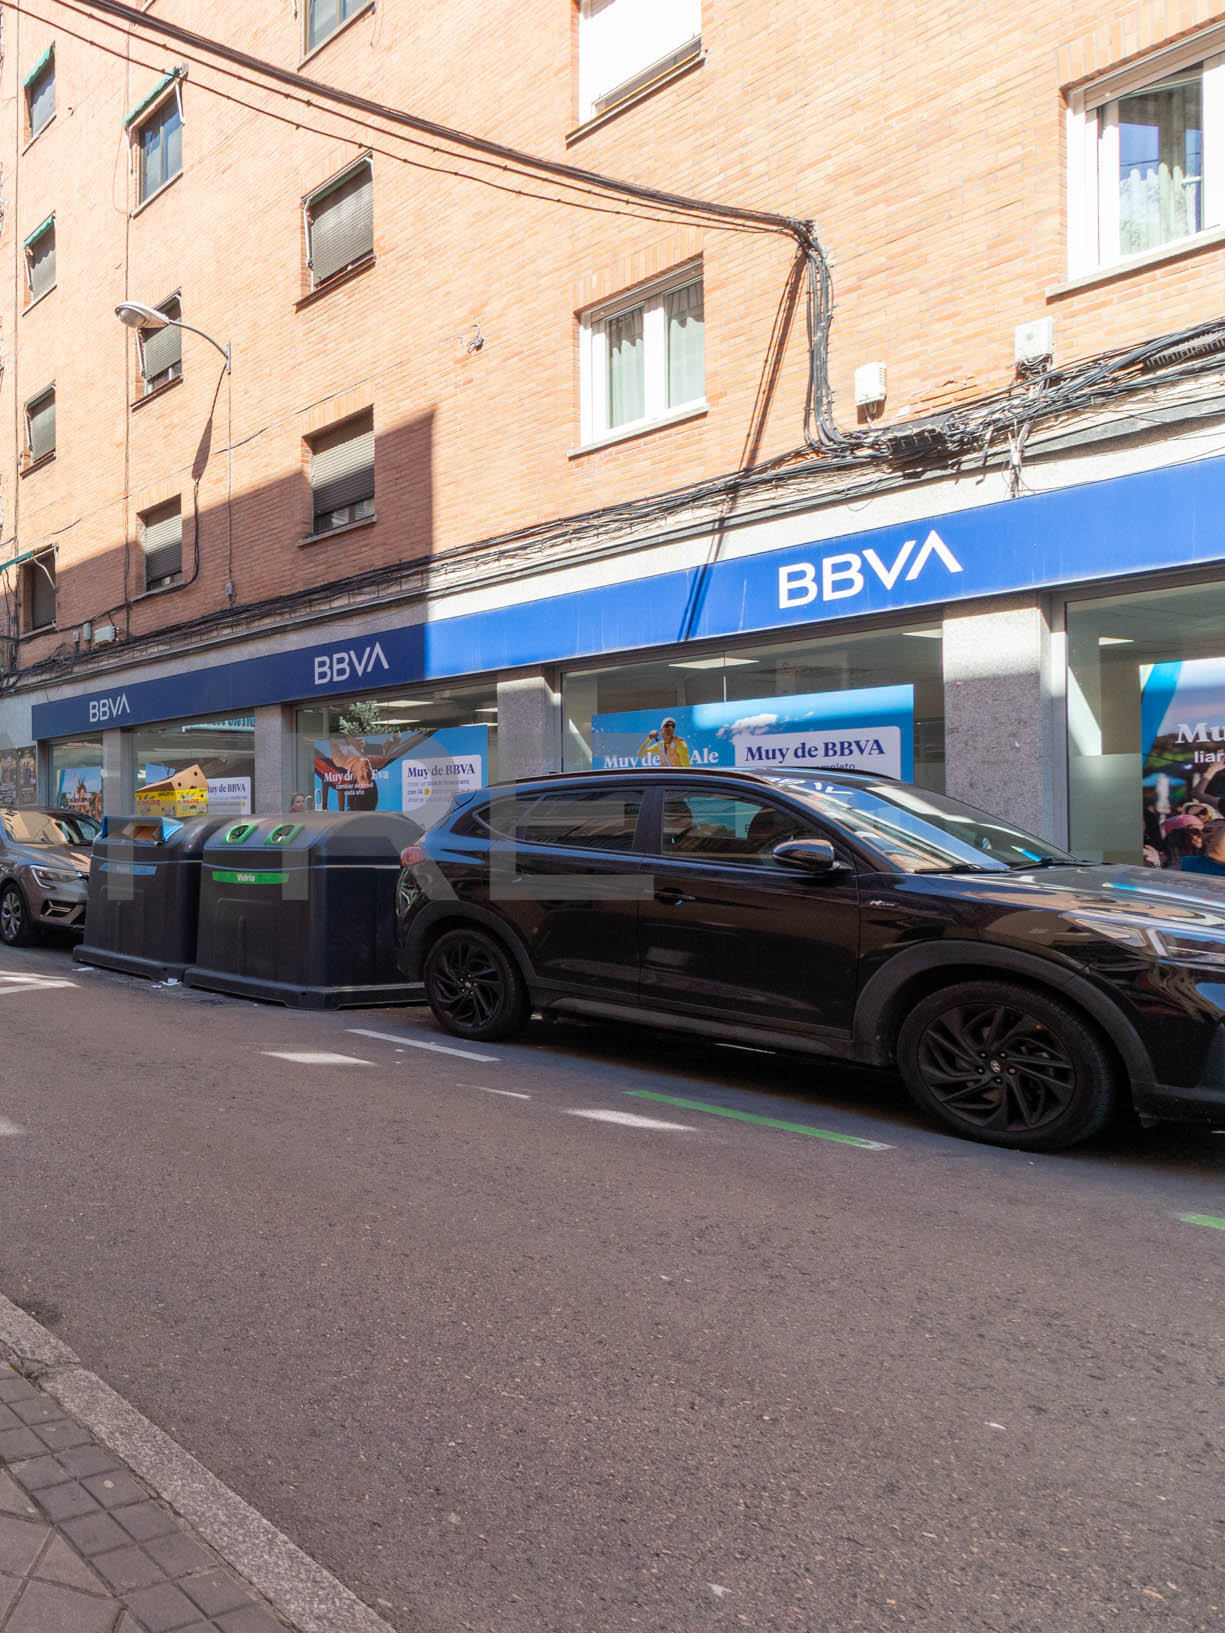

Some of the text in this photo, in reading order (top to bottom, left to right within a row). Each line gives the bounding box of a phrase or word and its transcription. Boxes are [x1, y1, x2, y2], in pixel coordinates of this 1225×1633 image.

[778, 529, 964, 609] BBVA
[313, 641, 389, 686] BBVA
[89, 692, 130, 723] BBVA
[690, 748, 720, 764] Ale
[745, 739, 886, 764] Muy de BBVA
[603, 752, 661, 768] Muy de
[324, 771, 343, 784] Muy
[408, 763, 476, 780] Muy de BBVA
[227, 783, 246, 793] BBVA
[237, 873, 255, 882] Vidrio
